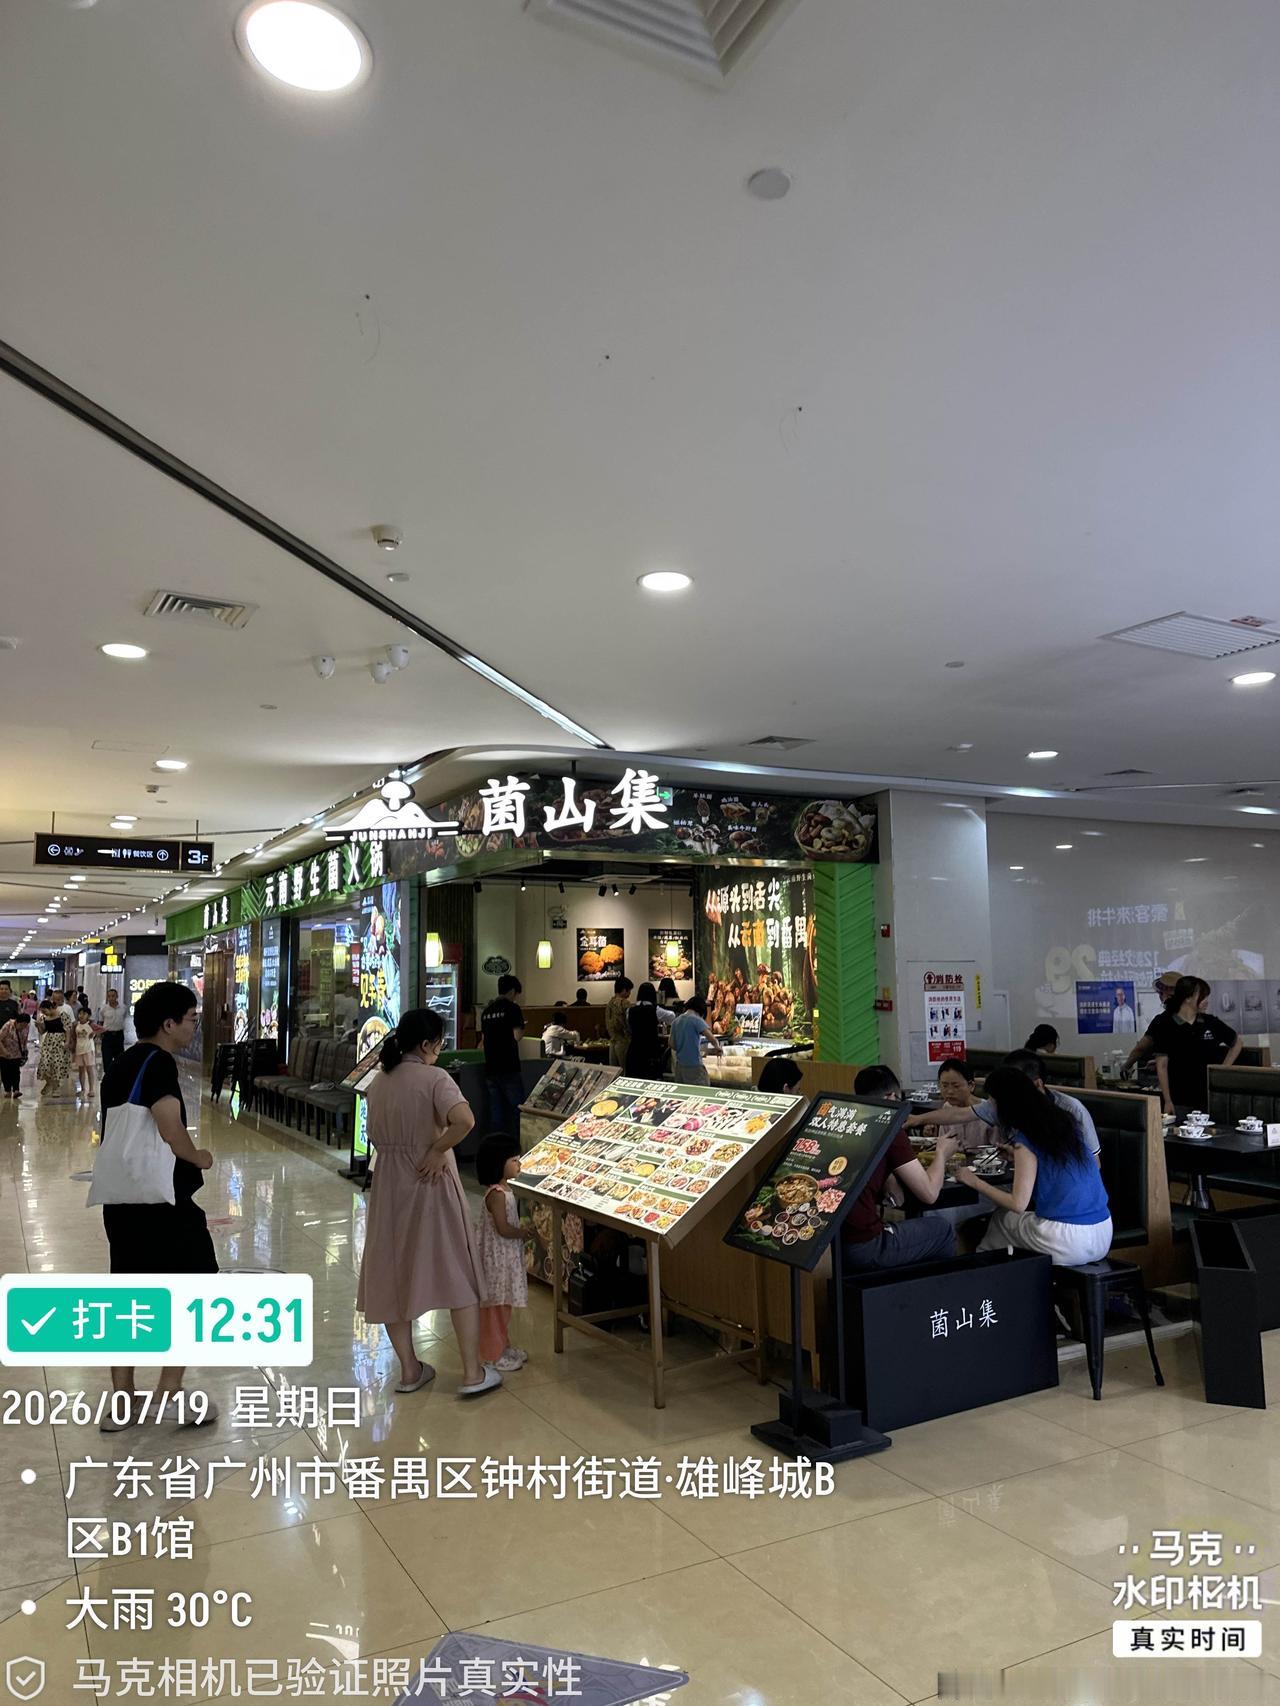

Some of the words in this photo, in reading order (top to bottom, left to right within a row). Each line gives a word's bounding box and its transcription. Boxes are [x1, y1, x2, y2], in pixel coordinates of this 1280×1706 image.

[478, 767, 669, 838] 菌山集
[349, 828, 433, 842] JUNSHANJI
[132, 850, 154, 859] 餐饮区
[187, 850, 209, 865] 3F
[265, 840, 384, 908] 云南野生菌火锅
[705, 877, 781, 914] 从源头到舌尖
[727, 915, 808, 949] 从云南到番禺
[935, 974, 963, 984] 消防栓
[808, 1116, 868, 1137] 双人特惠套餐
[792, 1138, 817, 1154] 158
[930, 1298, 999, 1340] 菌山集
